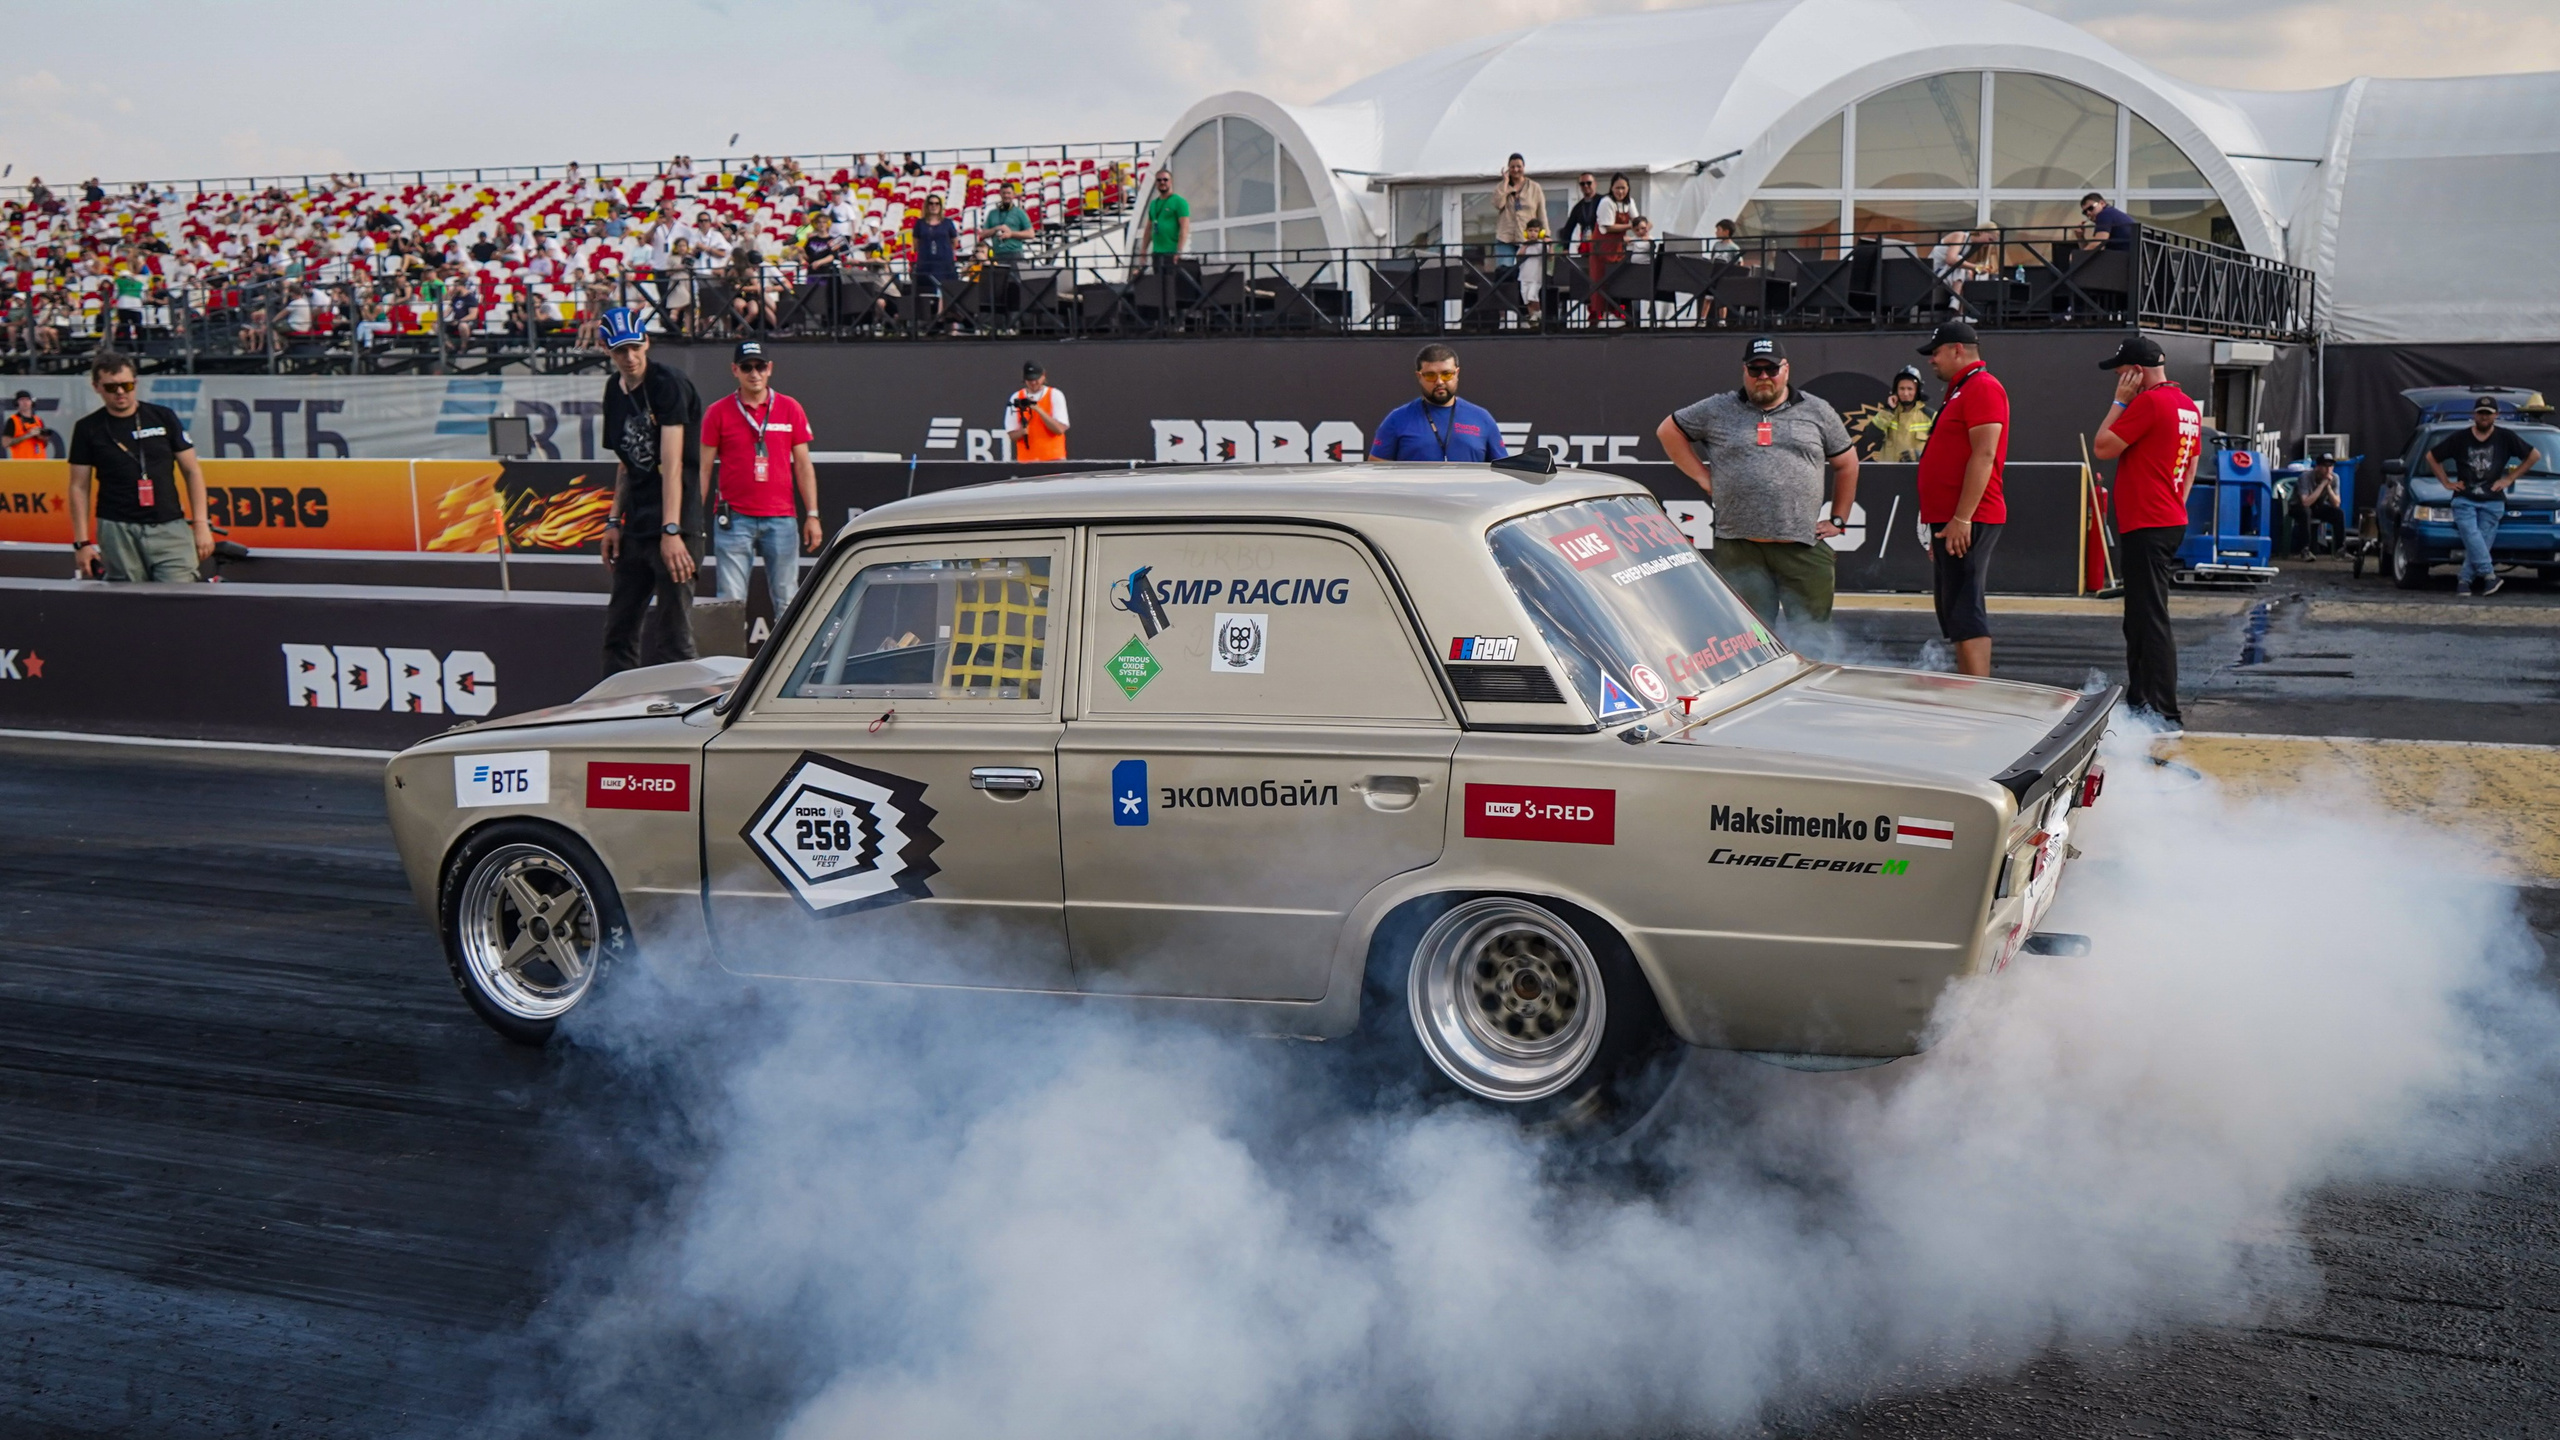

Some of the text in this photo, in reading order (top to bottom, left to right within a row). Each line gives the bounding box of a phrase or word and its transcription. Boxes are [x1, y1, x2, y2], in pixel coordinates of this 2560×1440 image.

[212, 398, 349, 458] ВТБ
[206, 487, 329, 528] RDRC
[1559, 543, 1578, 562] I
[1567, 533, 1610, 560] LIKE
[1611, 555, 1673, 587] ГЕНЕРАЛЬНЫЙ
[1156, 578, 1350, 606] SMP RACING
[282, 643, 497, 716] RDRC
[1122, 662, 1145, 670] OXIDE
[492, 769, 528, 794] ВТБ
[628, 775, 676, 792] 3-RED
[1161, 779, 1338, 808] экомобайл
[795, 807, 826, 816] RDRC
[1494, 805, 1515, 814] LIKE
[1525, 800, 1595, 821] 3-RED
[1710, 804, 1891, 842] Maksimenko G
[796, 819, 851, 851] 258
